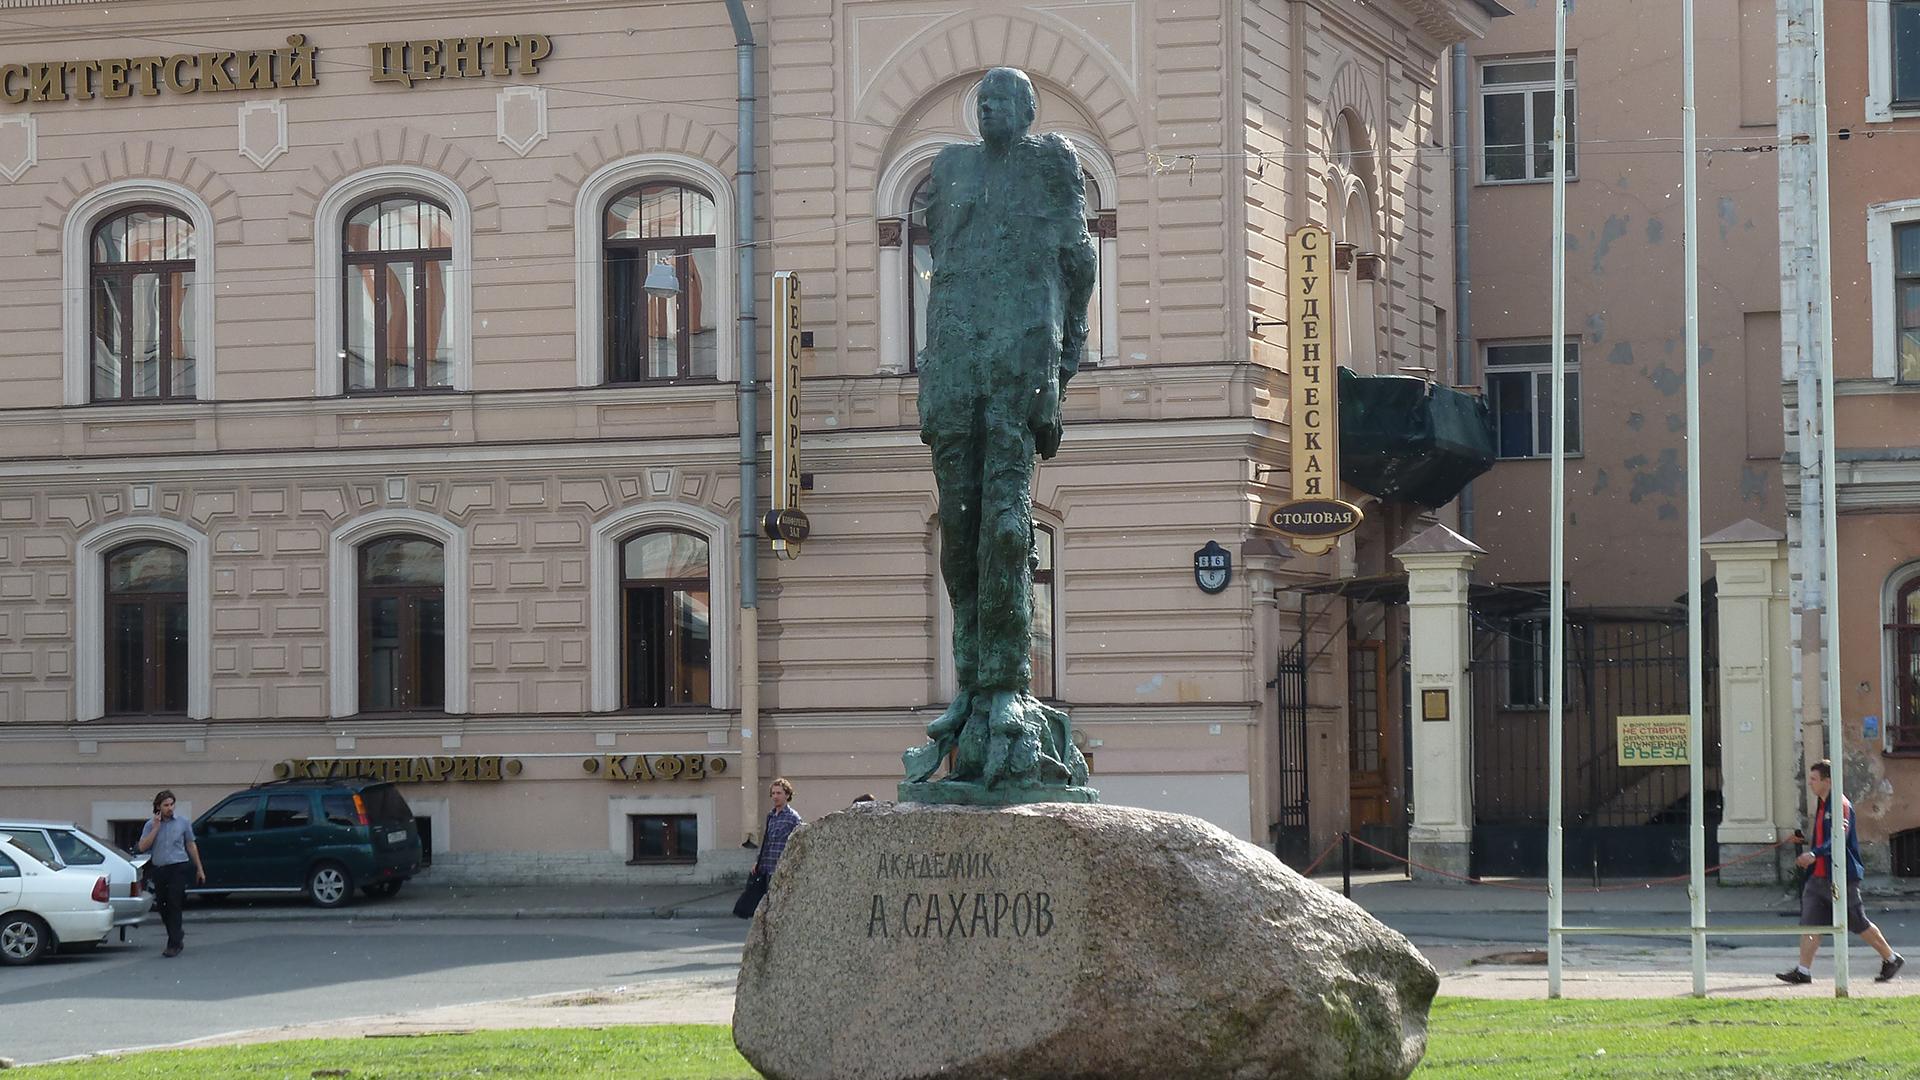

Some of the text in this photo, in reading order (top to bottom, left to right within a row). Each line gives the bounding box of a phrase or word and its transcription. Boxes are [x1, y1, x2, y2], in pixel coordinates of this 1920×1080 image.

[0, 33, 553, 104] СИТЕТСКИЙ ЦЕНТР
[1301, 232, 1321, 495] СТУДЕНЧЕСКАЯ
[789, 276, 799, 508] РЕСТОРАН
[1273, 511, 1353, 525] СТОЛОВАЯ
[1623, 727, 1637, 735] НЕ
[1623, 740, 1687, 748] СЛУЖЕБНЫЙ
[604, 753, 706, 782] КАФЕ
[1624, 747, 1688, 760] ВЪЕЗД
[876, 852, 996, 880] АКАДЕМИК
[903, 892, 1054, 938] САХАРОВ
